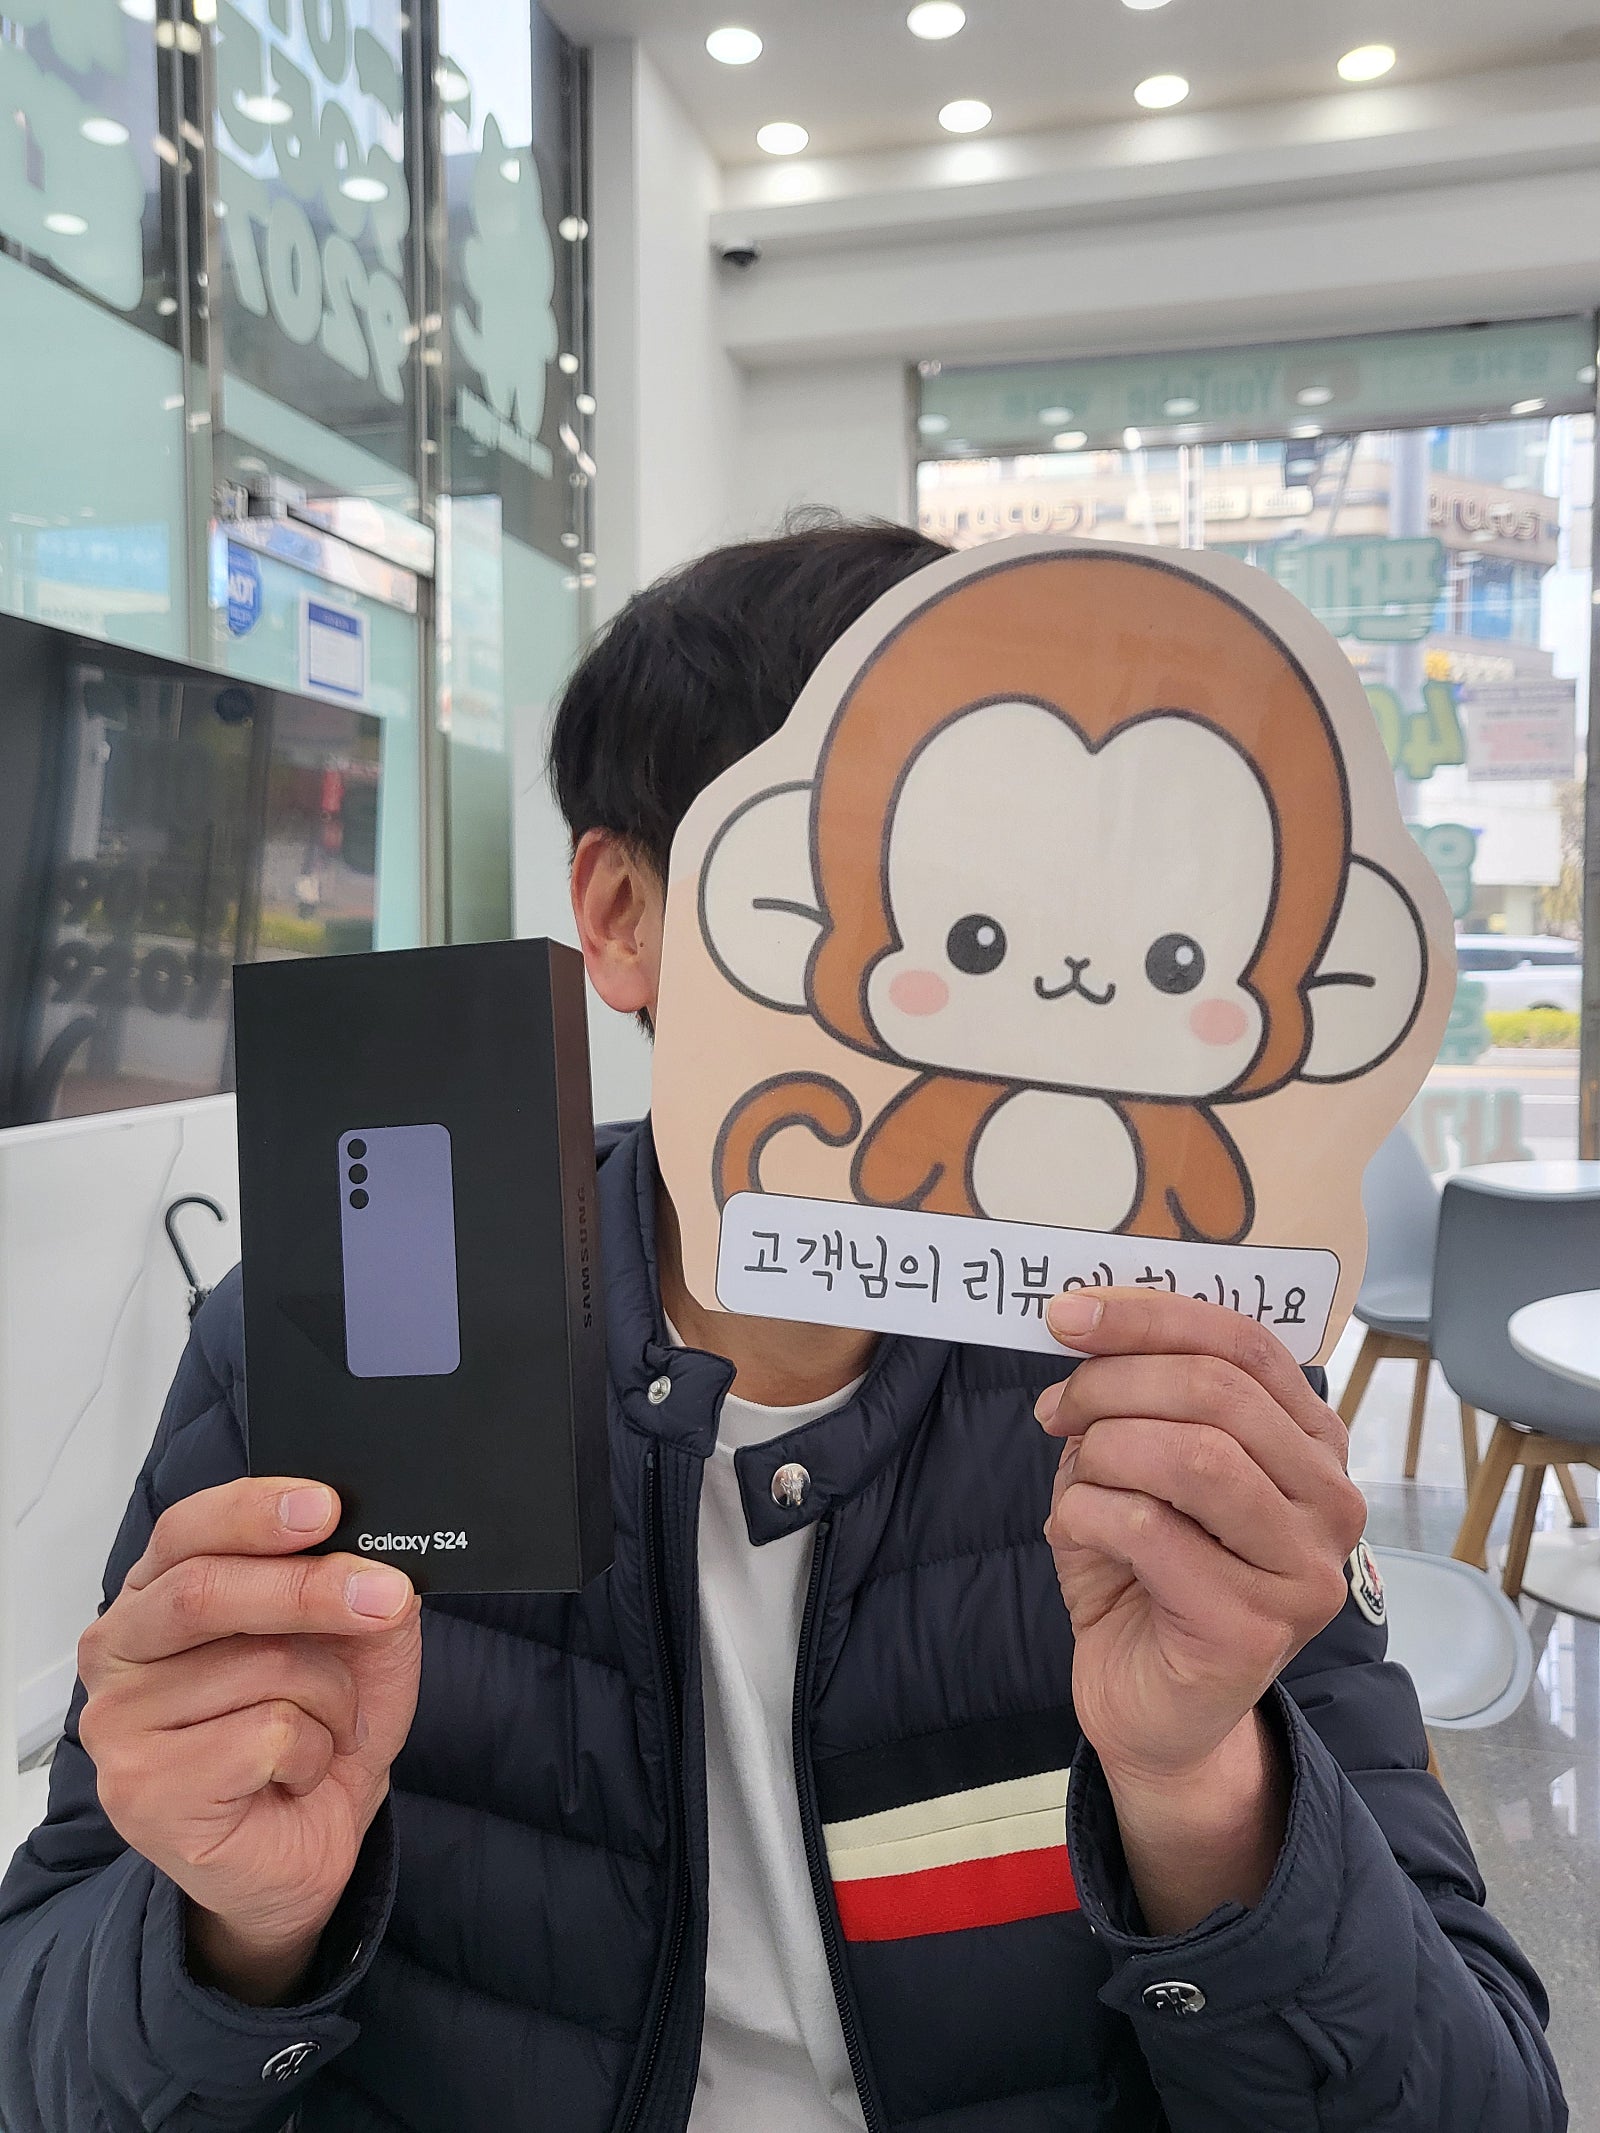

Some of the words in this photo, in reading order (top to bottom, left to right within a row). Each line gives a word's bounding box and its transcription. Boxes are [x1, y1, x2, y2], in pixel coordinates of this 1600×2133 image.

[577, 1183, 592, 1329] SAMSUNG
[744, 1229, 940, 1304] 고객님의
[358, 1532, 430, 1555] Galaxy
[433, 1531, 468, 1550] S24
